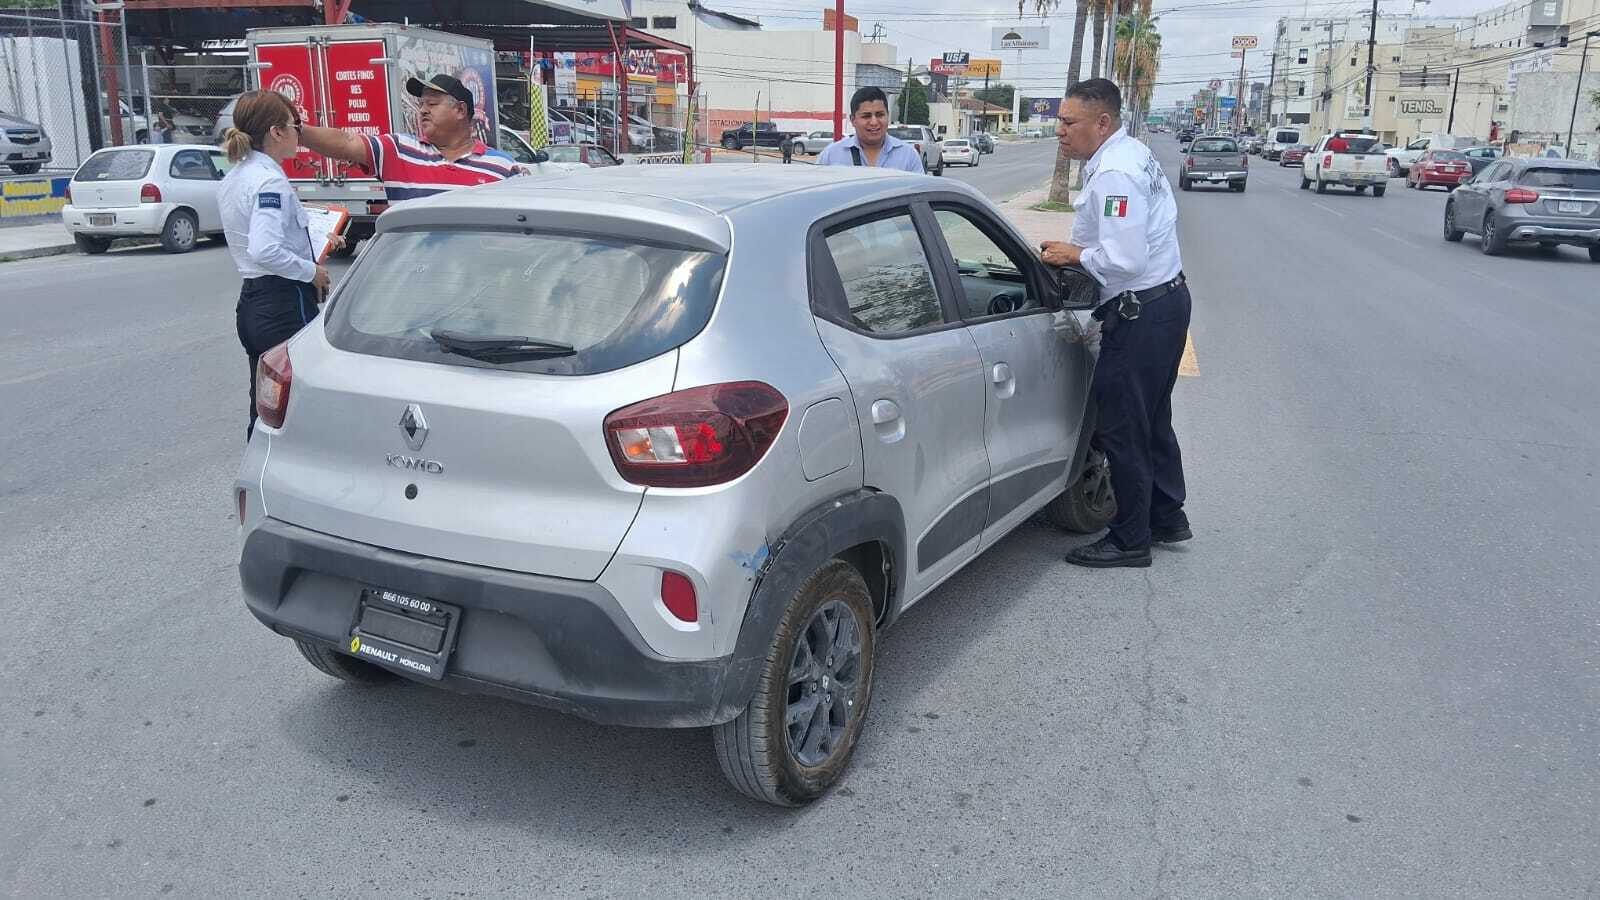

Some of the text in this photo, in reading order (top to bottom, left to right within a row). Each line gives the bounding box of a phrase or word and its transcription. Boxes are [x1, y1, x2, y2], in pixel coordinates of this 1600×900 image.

[945, 53, 965, 62] USF
[336, 70, 374, 80] CORTES FINOS
[351, 84, 362, 94] RES
[349, 99, 367, 108] POLLO
[348, 112, 370, 122] PUERCO
[385, 453, 443, 474] KWID
[360, 644, 398, 662] RENAULT
